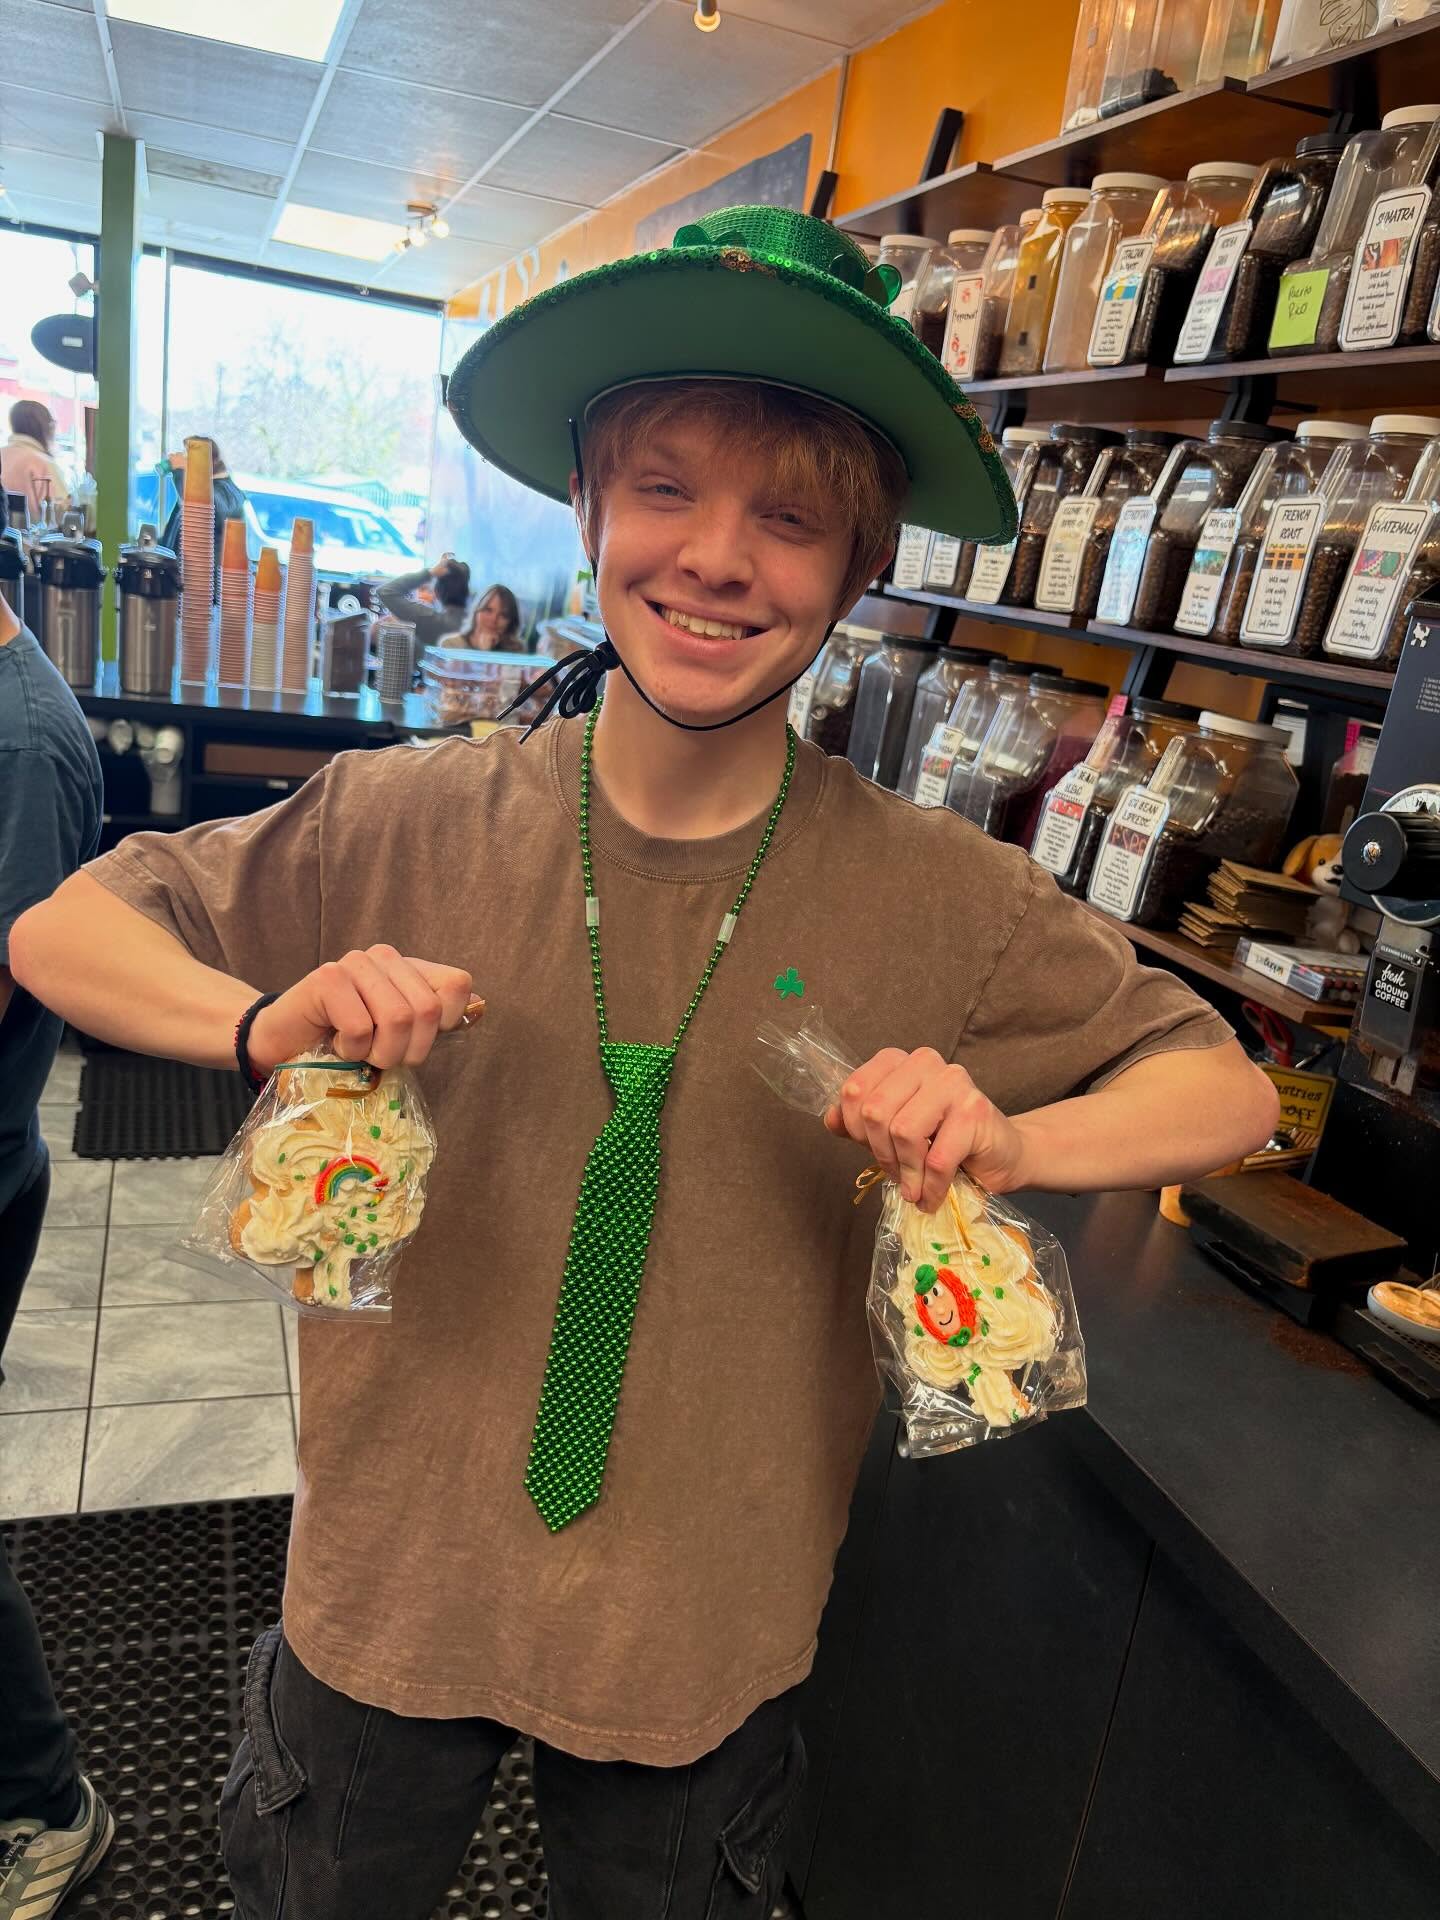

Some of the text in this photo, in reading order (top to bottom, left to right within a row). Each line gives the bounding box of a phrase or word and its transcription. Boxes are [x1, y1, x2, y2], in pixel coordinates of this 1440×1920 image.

[1376, 206, 1415, 226] SUMATRA
[1283, 509, 1311, 521] FRENCH
[1280, 527, 1303, 540] ROAST
[1372, 520, 1420, 536] GUATEMALA
[1381, 963, 1406, 987] fresh
[1375, 980, 1409, 1000] GROUND
[1375, 989, 1406, 1009] COFFEE
[1278, 1085, 1322, 1102] astries
